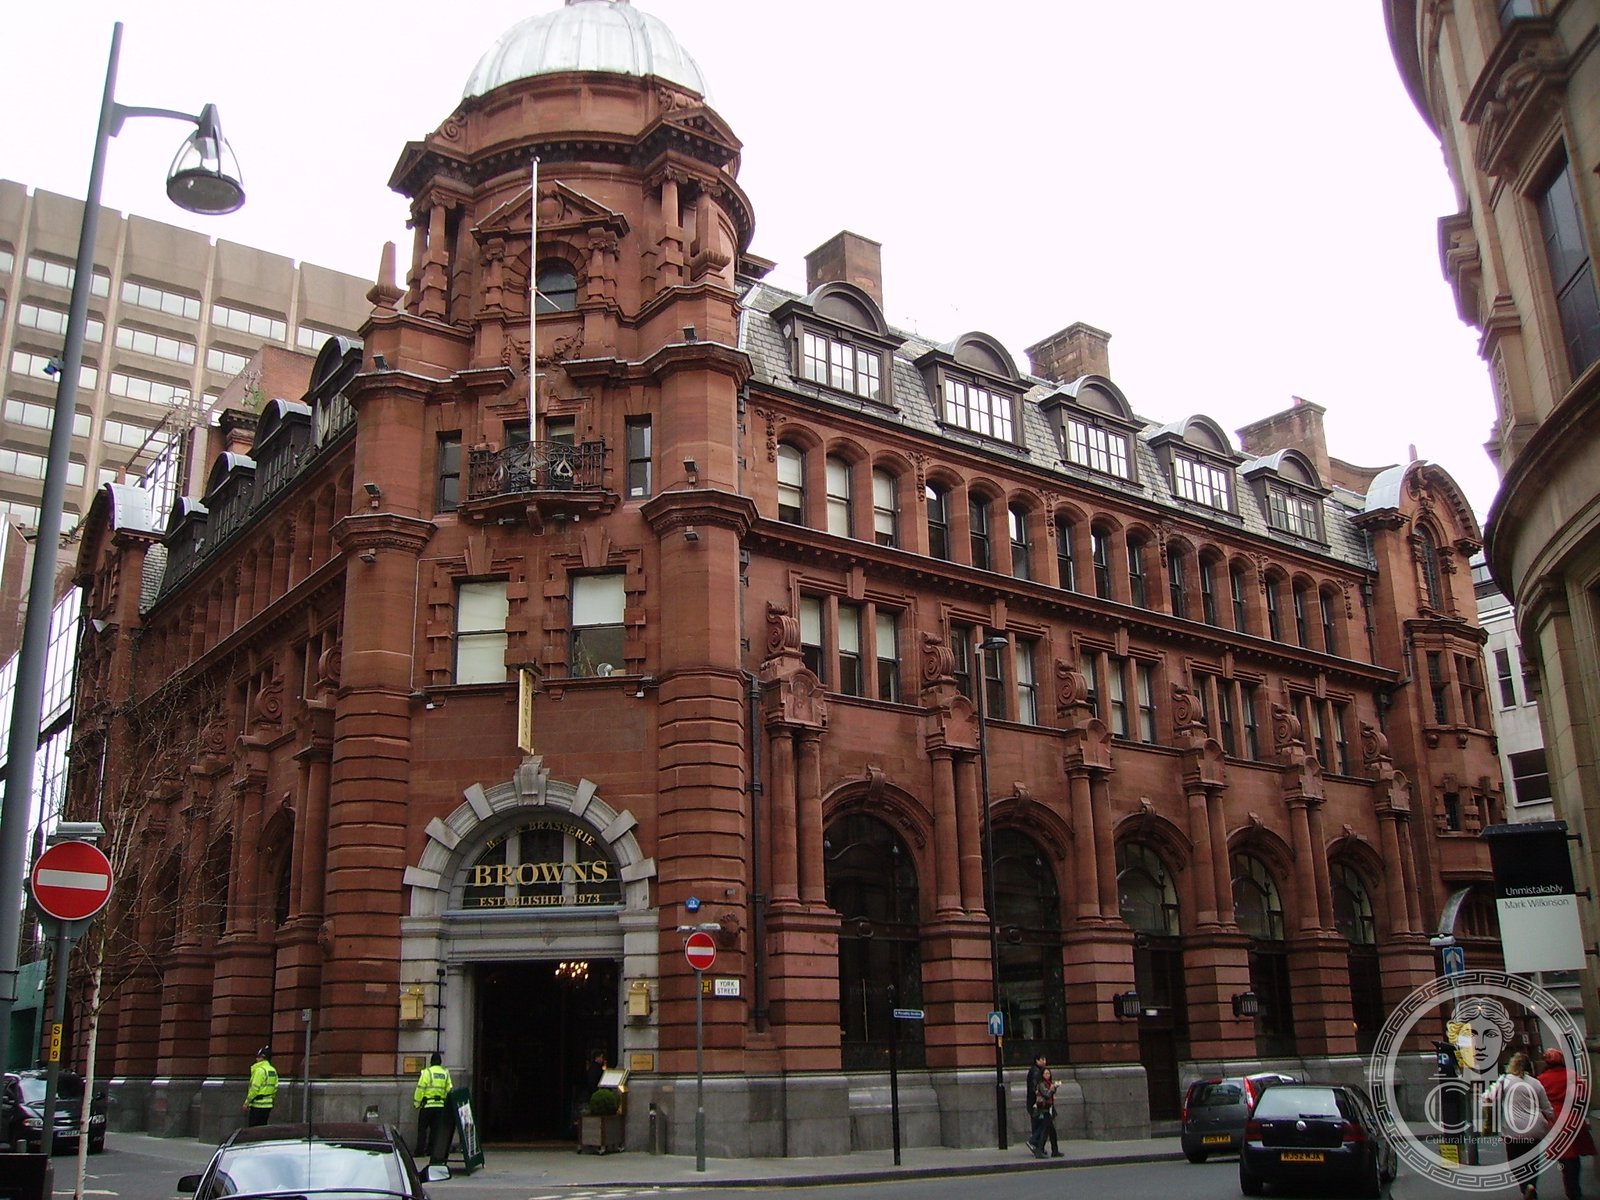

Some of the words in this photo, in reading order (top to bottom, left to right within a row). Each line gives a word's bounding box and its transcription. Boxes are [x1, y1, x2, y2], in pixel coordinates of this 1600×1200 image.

[528, 820, 596, 847] BRASSERIE
[474, 860, 609, 887] BROWNS
[1505, 884, 1563, 896] Unmistakably
[479, 896, 566, 907] ESTABLISHED
[573, 893, 600, 904] 1973
[1504, 899, 1526, 909] Mark
[1527, 898, 1569, 908] Wilkinson
